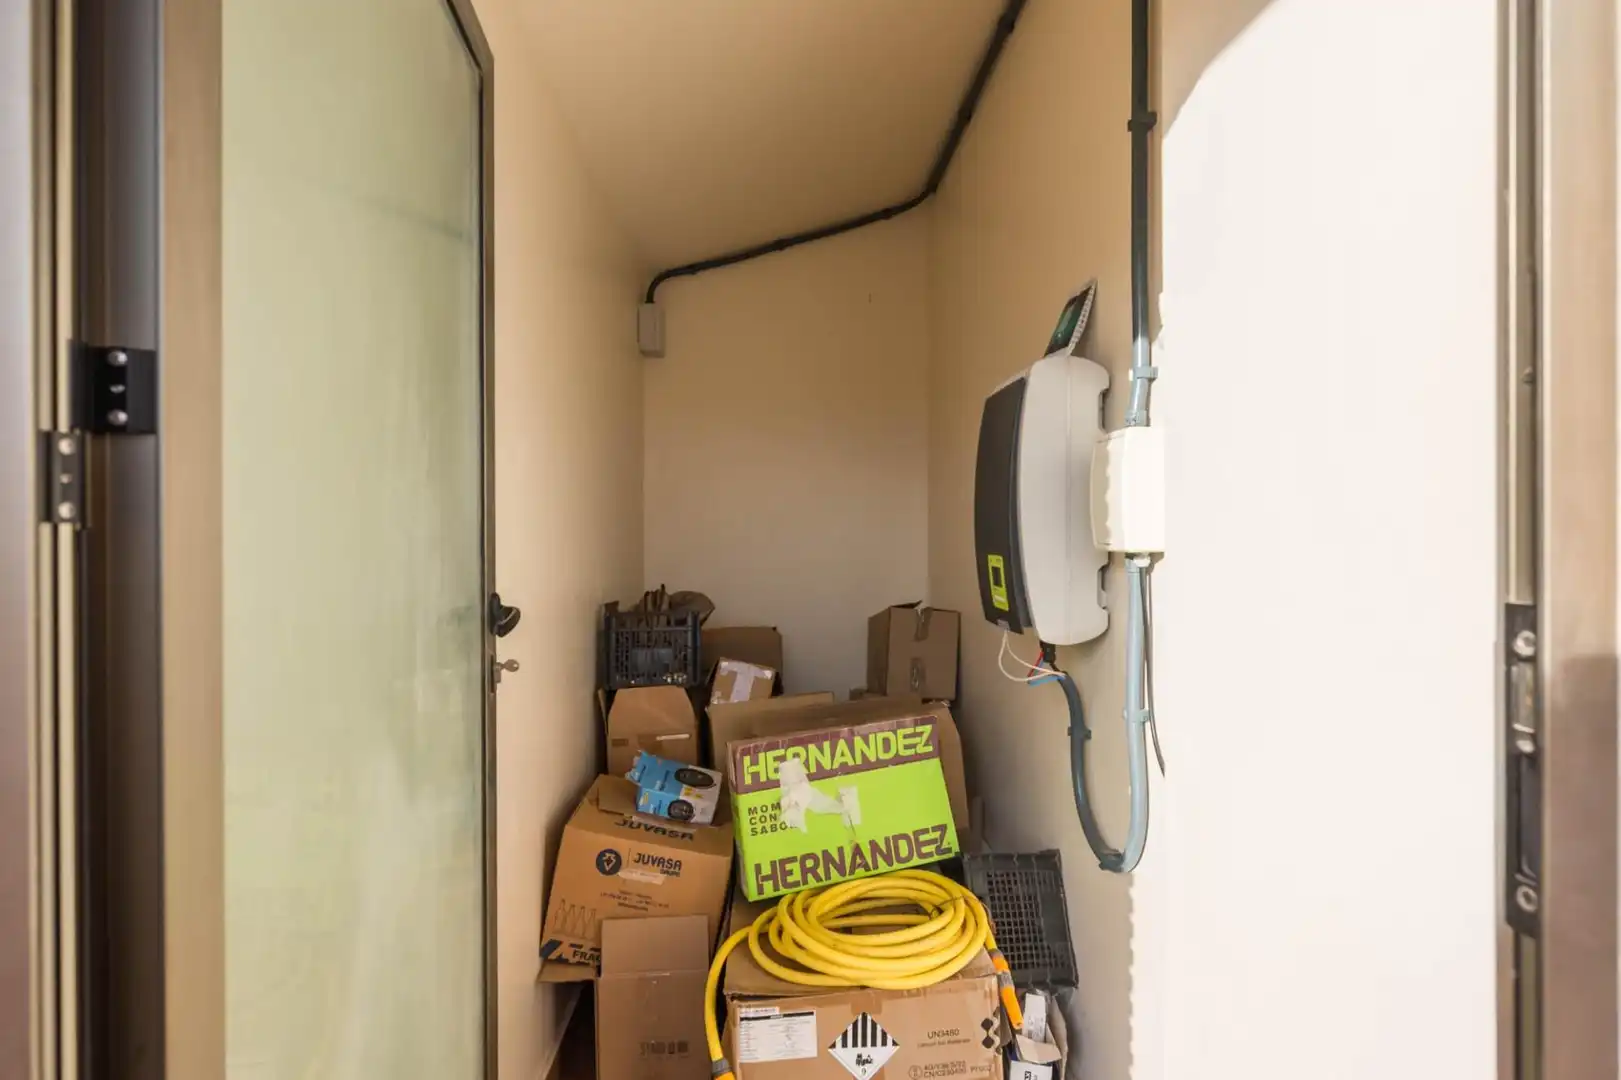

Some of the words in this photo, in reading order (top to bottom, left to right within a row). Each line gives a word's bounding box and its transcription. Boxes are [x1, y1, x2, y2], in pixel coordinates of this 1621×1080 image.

[743, 724, 934, 785] HERNANDEZ
[614, 818, 694, 842] JUVASA
[749, 813, 777, 825] CON
[750, 820, 798, 837] SABO
[633, 851, 682, 871] JUVASA
[754, 824, 953, 896] HERNANDEZ
